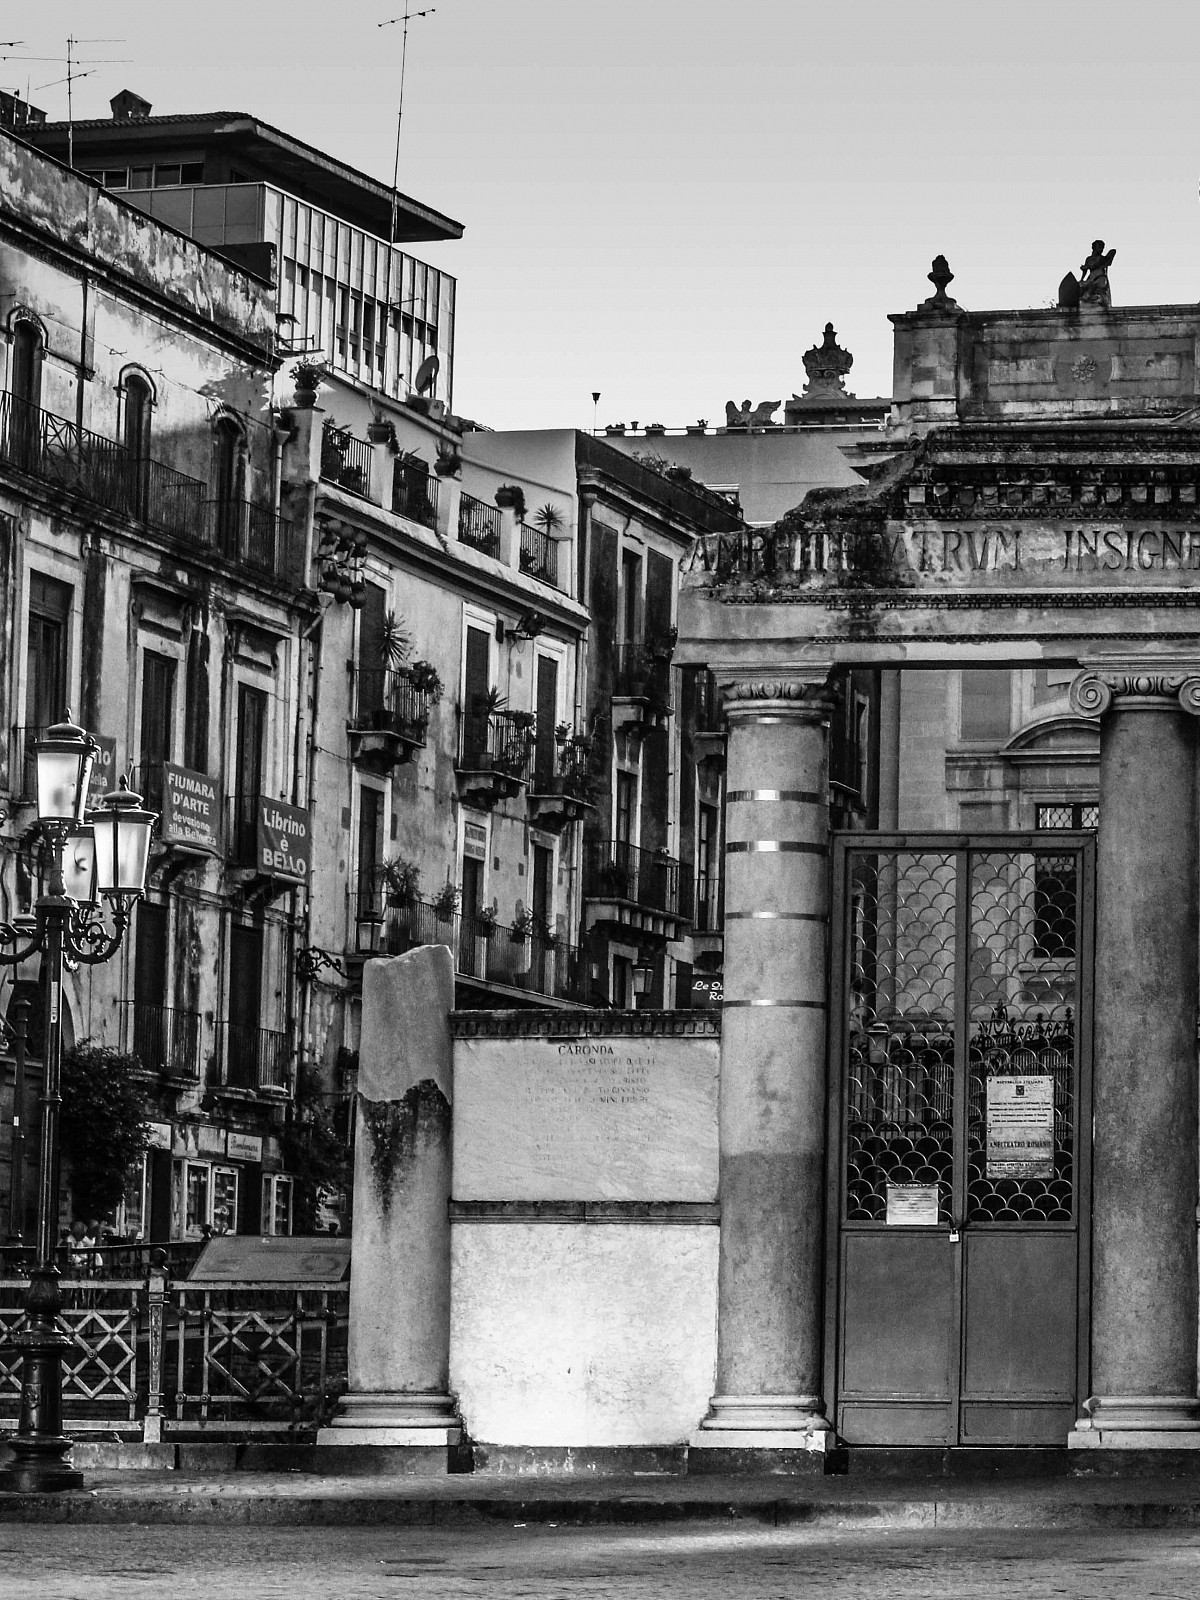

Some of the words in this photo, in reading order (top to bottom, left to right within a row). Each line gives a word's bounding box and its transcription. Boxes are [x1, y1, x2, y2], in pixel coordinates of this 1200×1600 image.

[168, 772, 215, 800] FIUMARA
[173, 791, 210, 816] D'ARTE
[263, 807, 306, 838] Librino
[280, 833, 289, 852] è
[263, 847, 307, 876] BELLO
[558, 1045, 614, 1056] CARONDA
